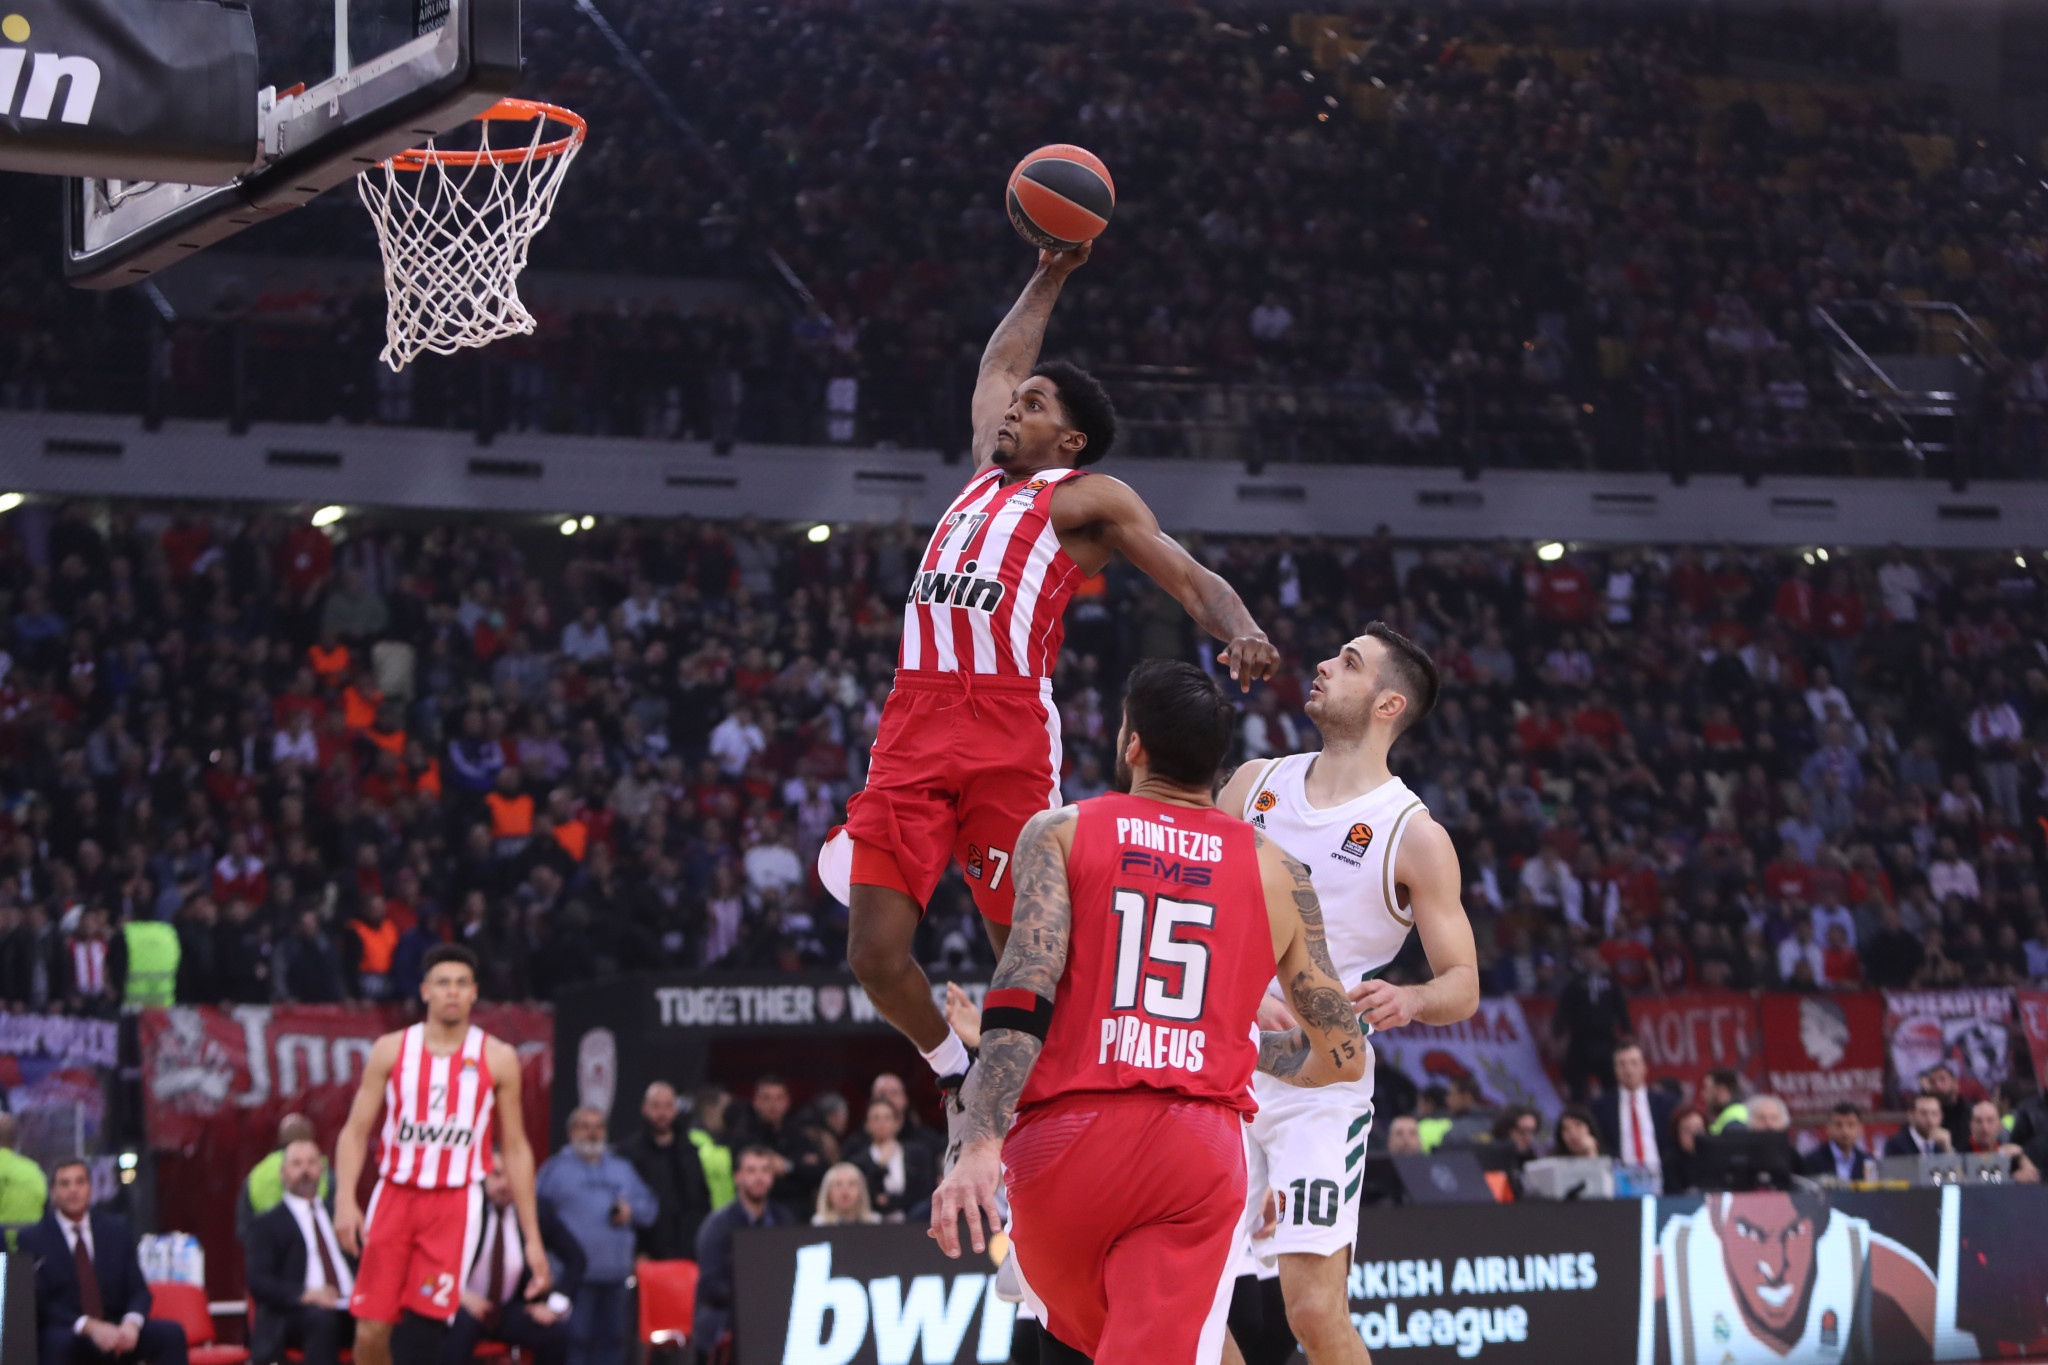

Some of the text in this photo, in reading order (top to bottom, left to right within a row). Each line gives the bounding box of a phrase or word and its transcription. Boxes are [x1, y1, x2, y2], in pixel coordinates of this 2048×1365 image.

[937, 512, 989, 553] 77
[1116, 817, 1223, 863] PRINTEZIS
[1331, 852, 1361, 868] oneteam
[1121, 851, 1213, 887] FMS
[1110, 886, 1217, 1023] 15
[655, 985, 816, 1026] TOGETHER
[1098, 1015, 1206, 1073] PIRAEUS
[1328, 1039, 1355, 1069] 15
[430, 1084, 446, 1112] 2
[397, 1115, 474, 1147] bwin
[1290, 1177, 1339, 1228] 10
[432, 1273, 456, 1308] 2
[1451, 1251, 1598, 1296] AIRLINES
